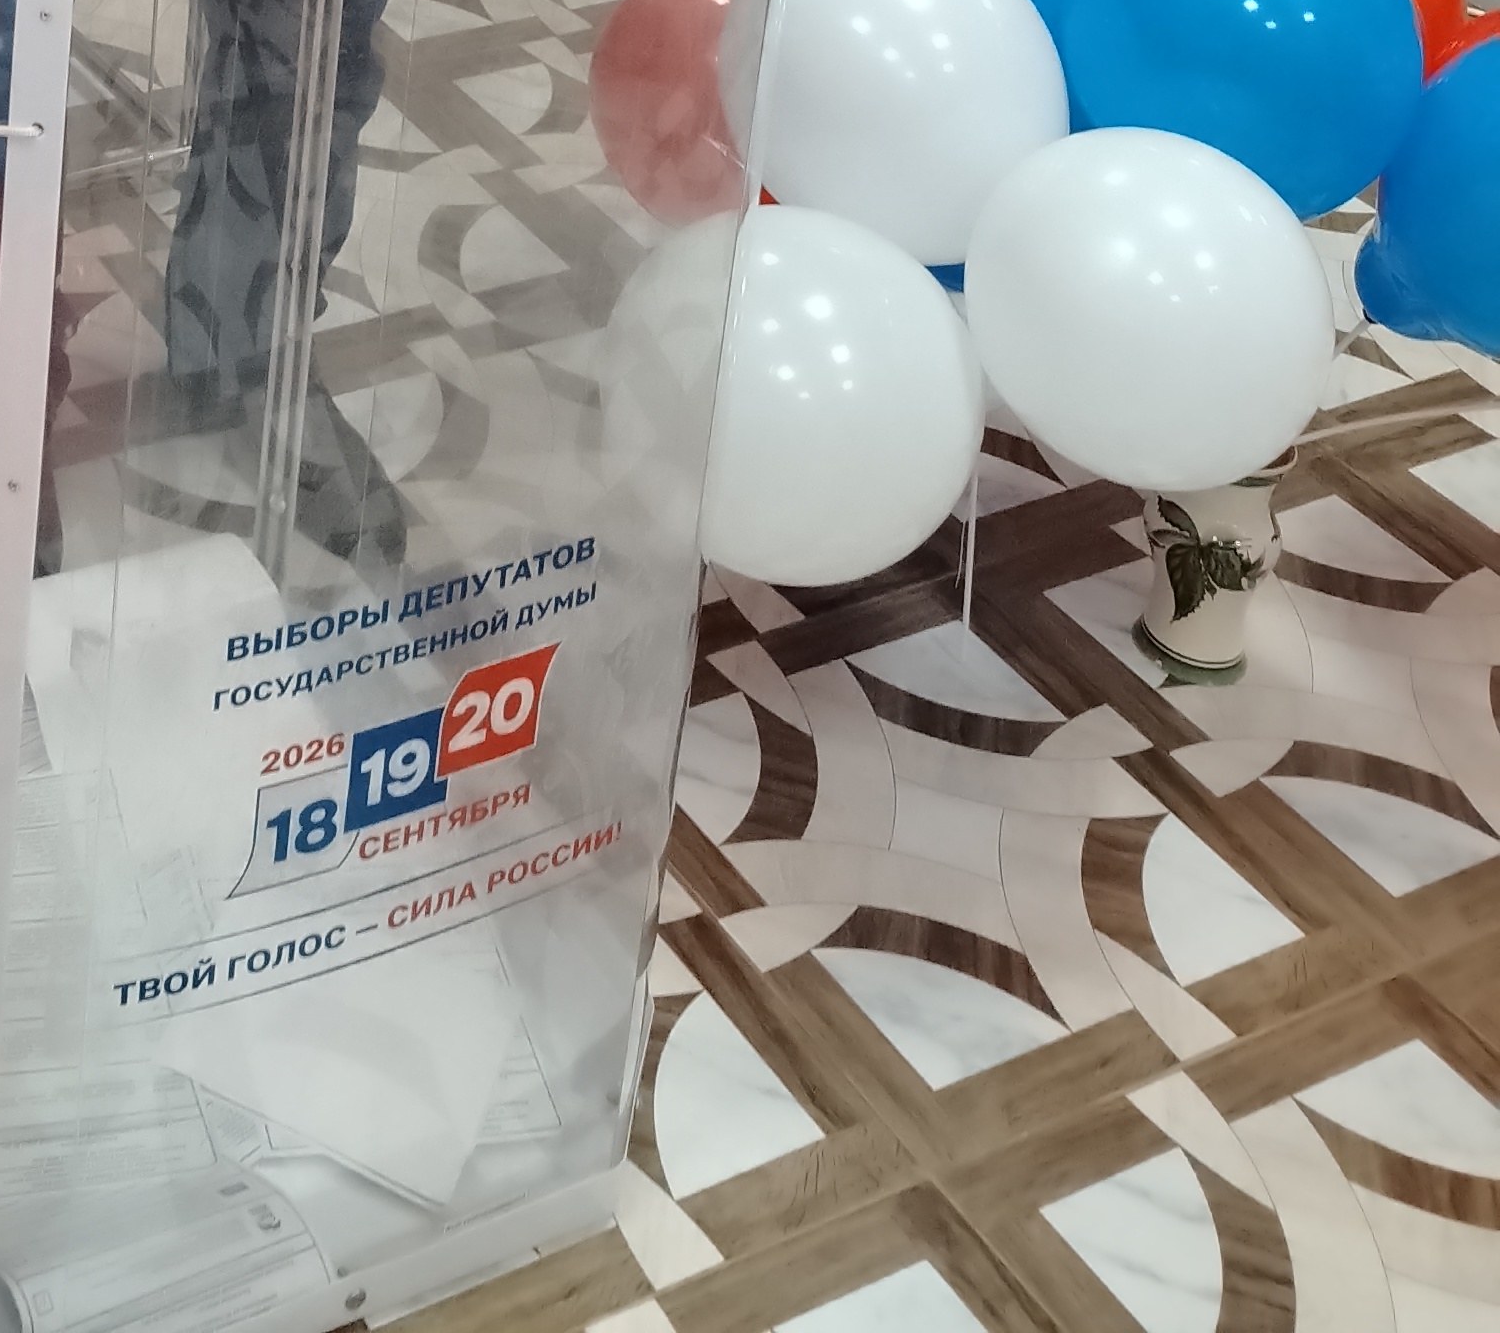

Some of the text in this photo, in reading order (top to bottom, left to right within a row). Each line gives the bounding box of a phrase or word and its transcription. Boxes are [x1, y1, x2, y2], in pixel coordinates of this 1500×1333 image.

[212, 581, 598, 712] ГОСУДАРСТВЕННОЙ ДУМЫ
[226, 536, 597, 663] ВЫБОРЫ ДЕПУТАТОВ
[260, 732, 346, 777] 2026
[265, 676, 535, 864] 18 19 20
[357, 781, 532, 862] СЕНТЯБРЯ
[113, 958, 217, 1008] ТВОЙ
[227, 924, 347, 982] ГОЛОС
[386, 881, 479, 930] СИЛА
[486, 820, 624, 894] РОССИИ!
